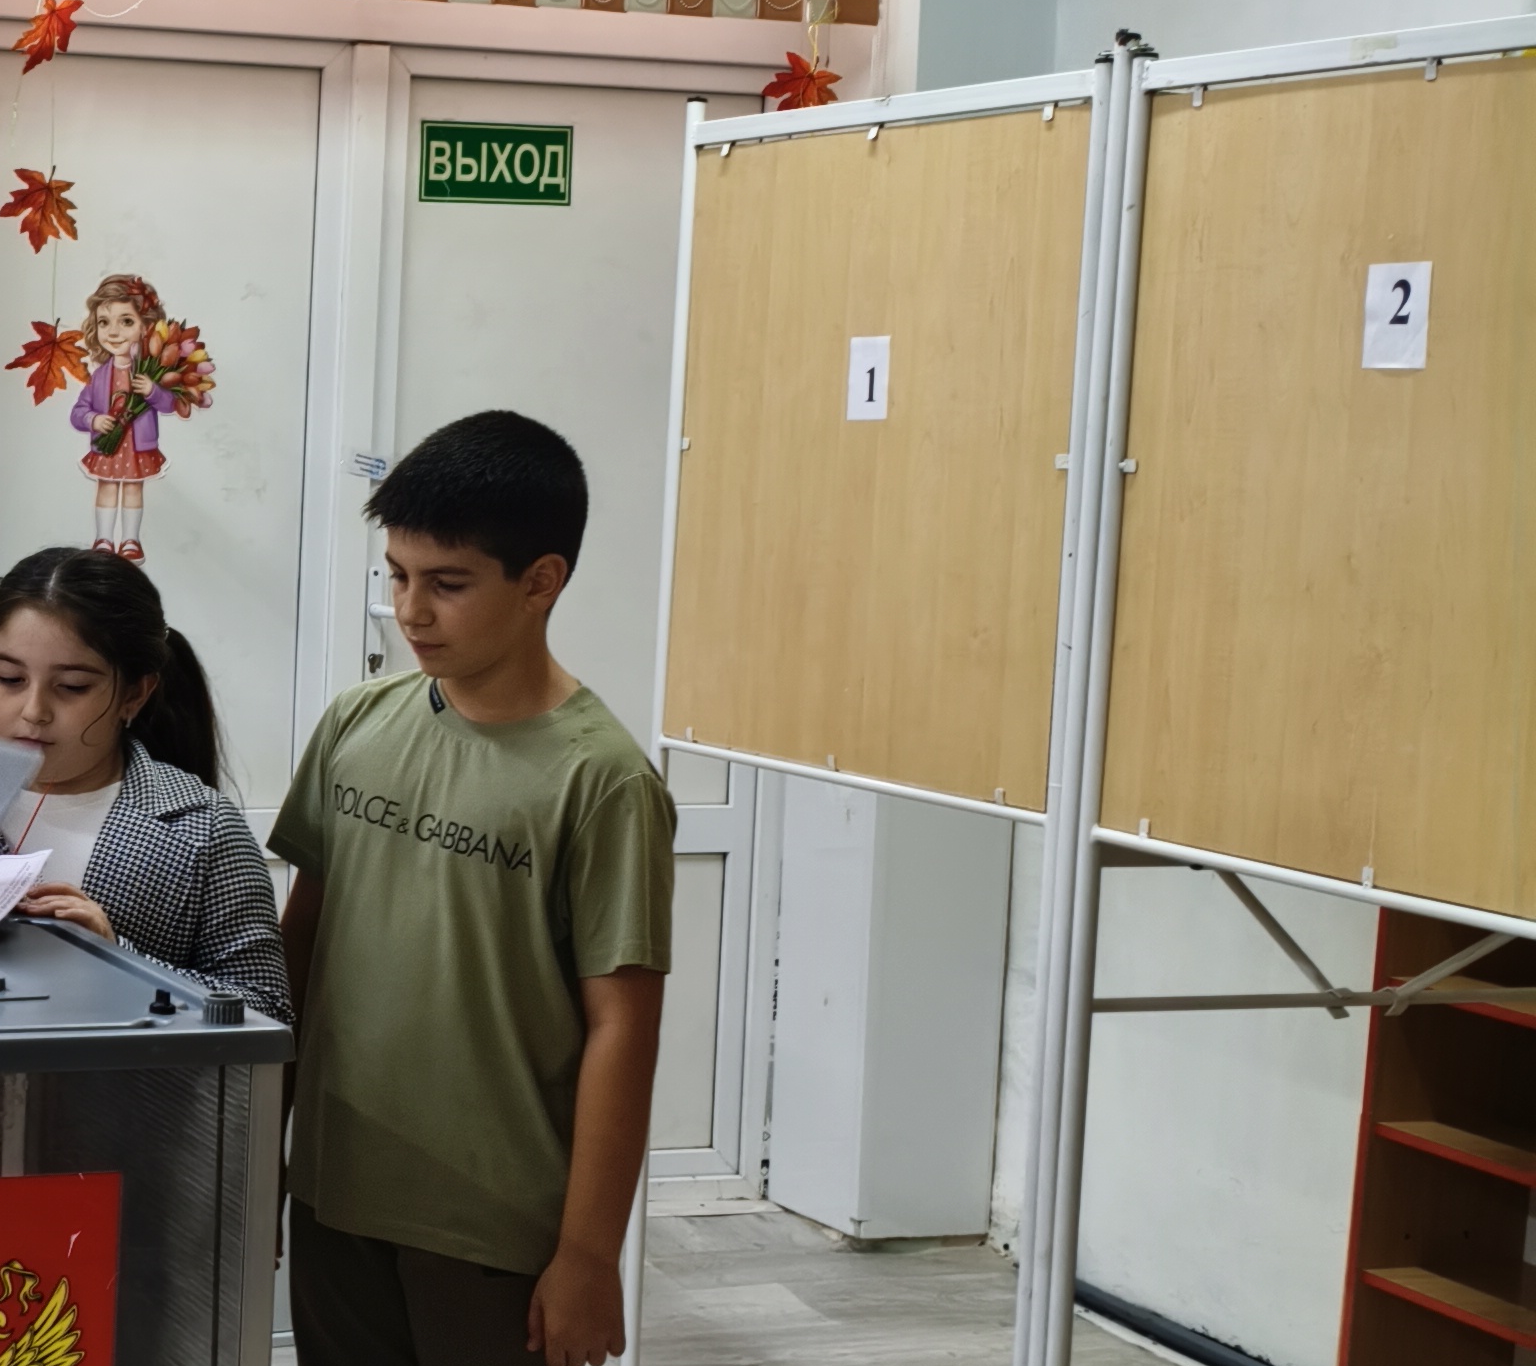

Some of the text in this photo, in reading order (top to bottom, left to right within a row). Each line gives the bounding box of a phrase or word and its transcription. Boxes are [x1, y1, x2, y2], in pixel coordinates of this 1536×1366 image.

[428, 140, 566, 193] ВЫХОД
[1388, 279, 1412, 325] 2
[865, 366, 877, 403] 1
[396, 817, 410, 835] &
[414, 813, 533, 878] GABBANA
